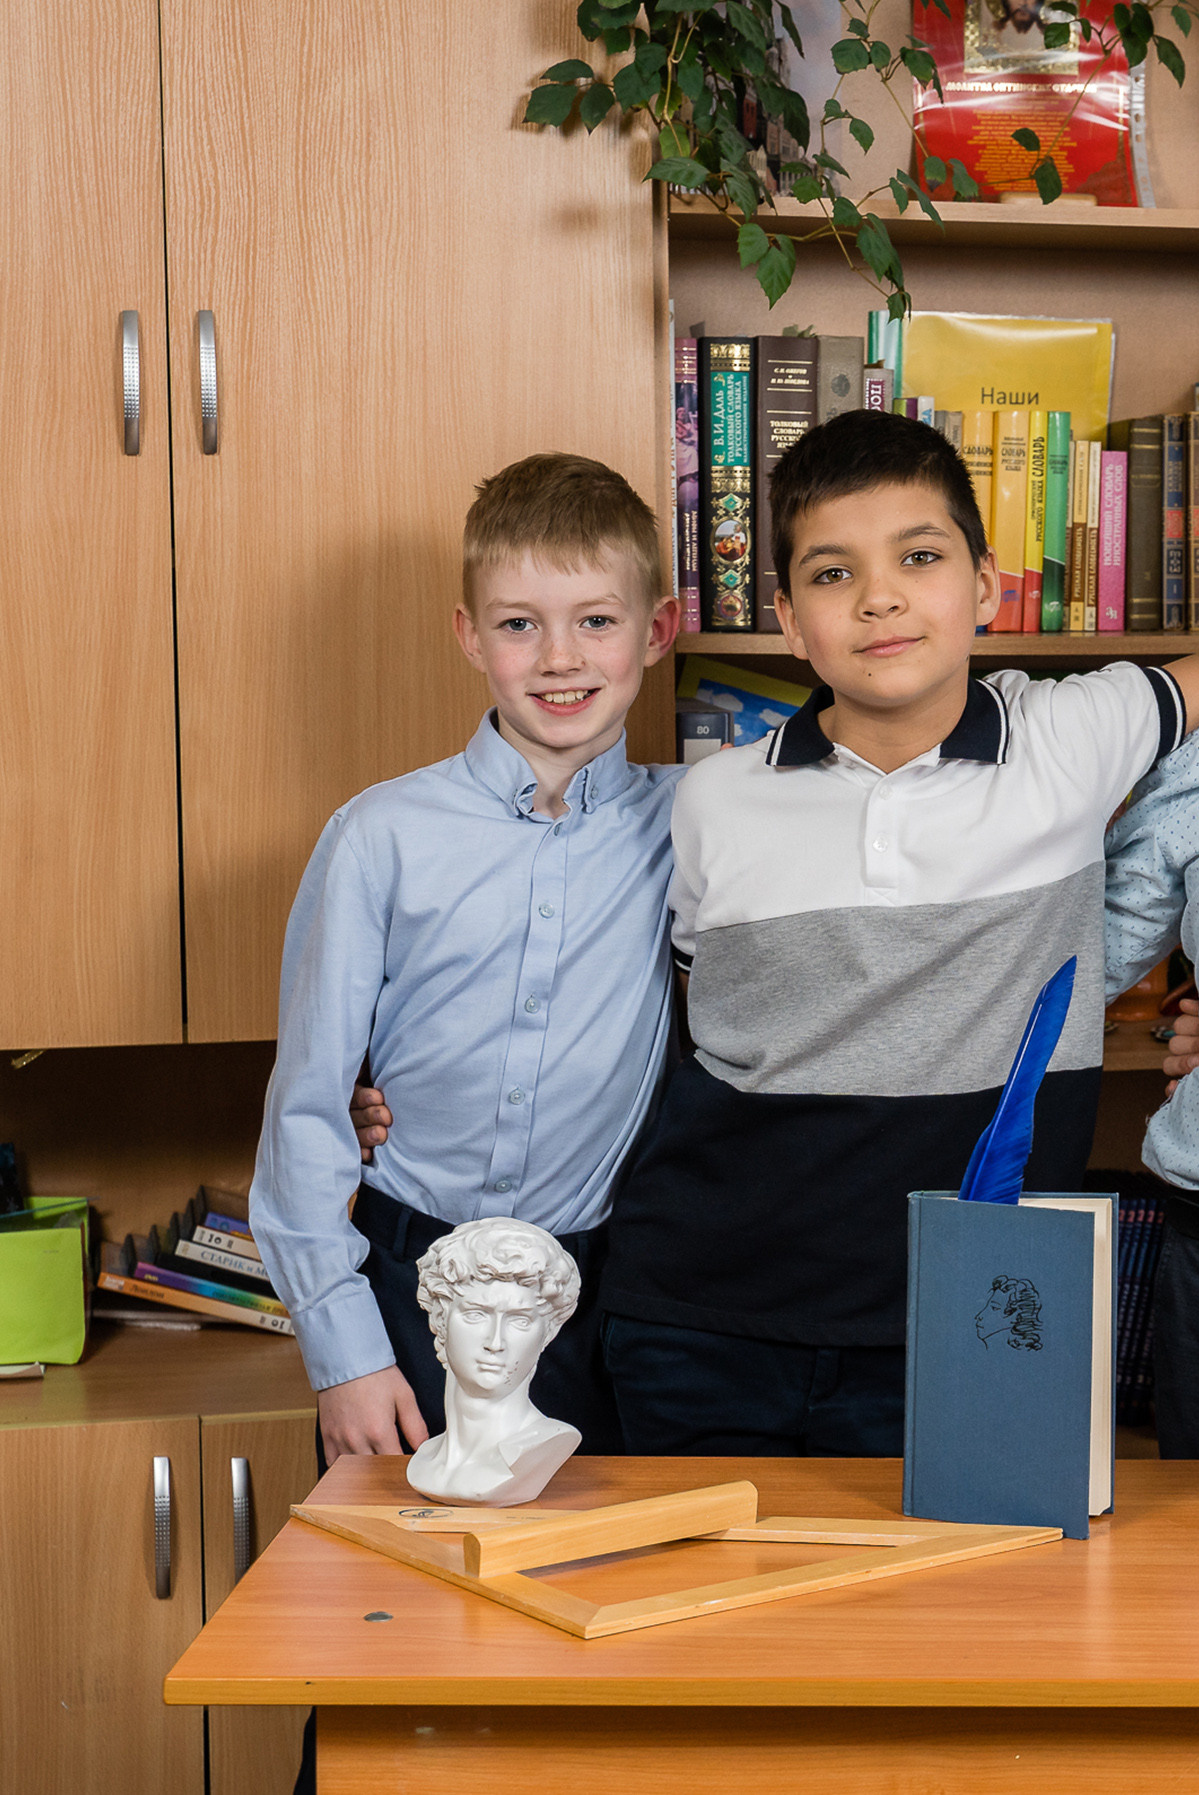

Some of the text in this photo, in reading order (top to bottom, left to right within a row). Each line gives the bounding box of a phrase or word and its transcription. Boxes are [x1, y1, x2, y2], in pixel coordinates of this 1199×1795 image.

[725, 374, 735, 463] ТОЛКОВЫЙ СЛОВАРЬ
[734, 381, 742, 457] РУССКОГО ЯЗЫКА
[981, 387, 1040, 405] Наши
[1032, 436, 1045, 477] СЛОВАРЬ
[1103, 464, 1114, 566] НОВЕЙШИЙ СЛОВАРЬ
[1113, 465, 1123, 566] ИНОСТРАННЫХ СЛОВ
[696, 725, 710, 735] 80
[201, 1251, 245, 1271] СТАРИК
